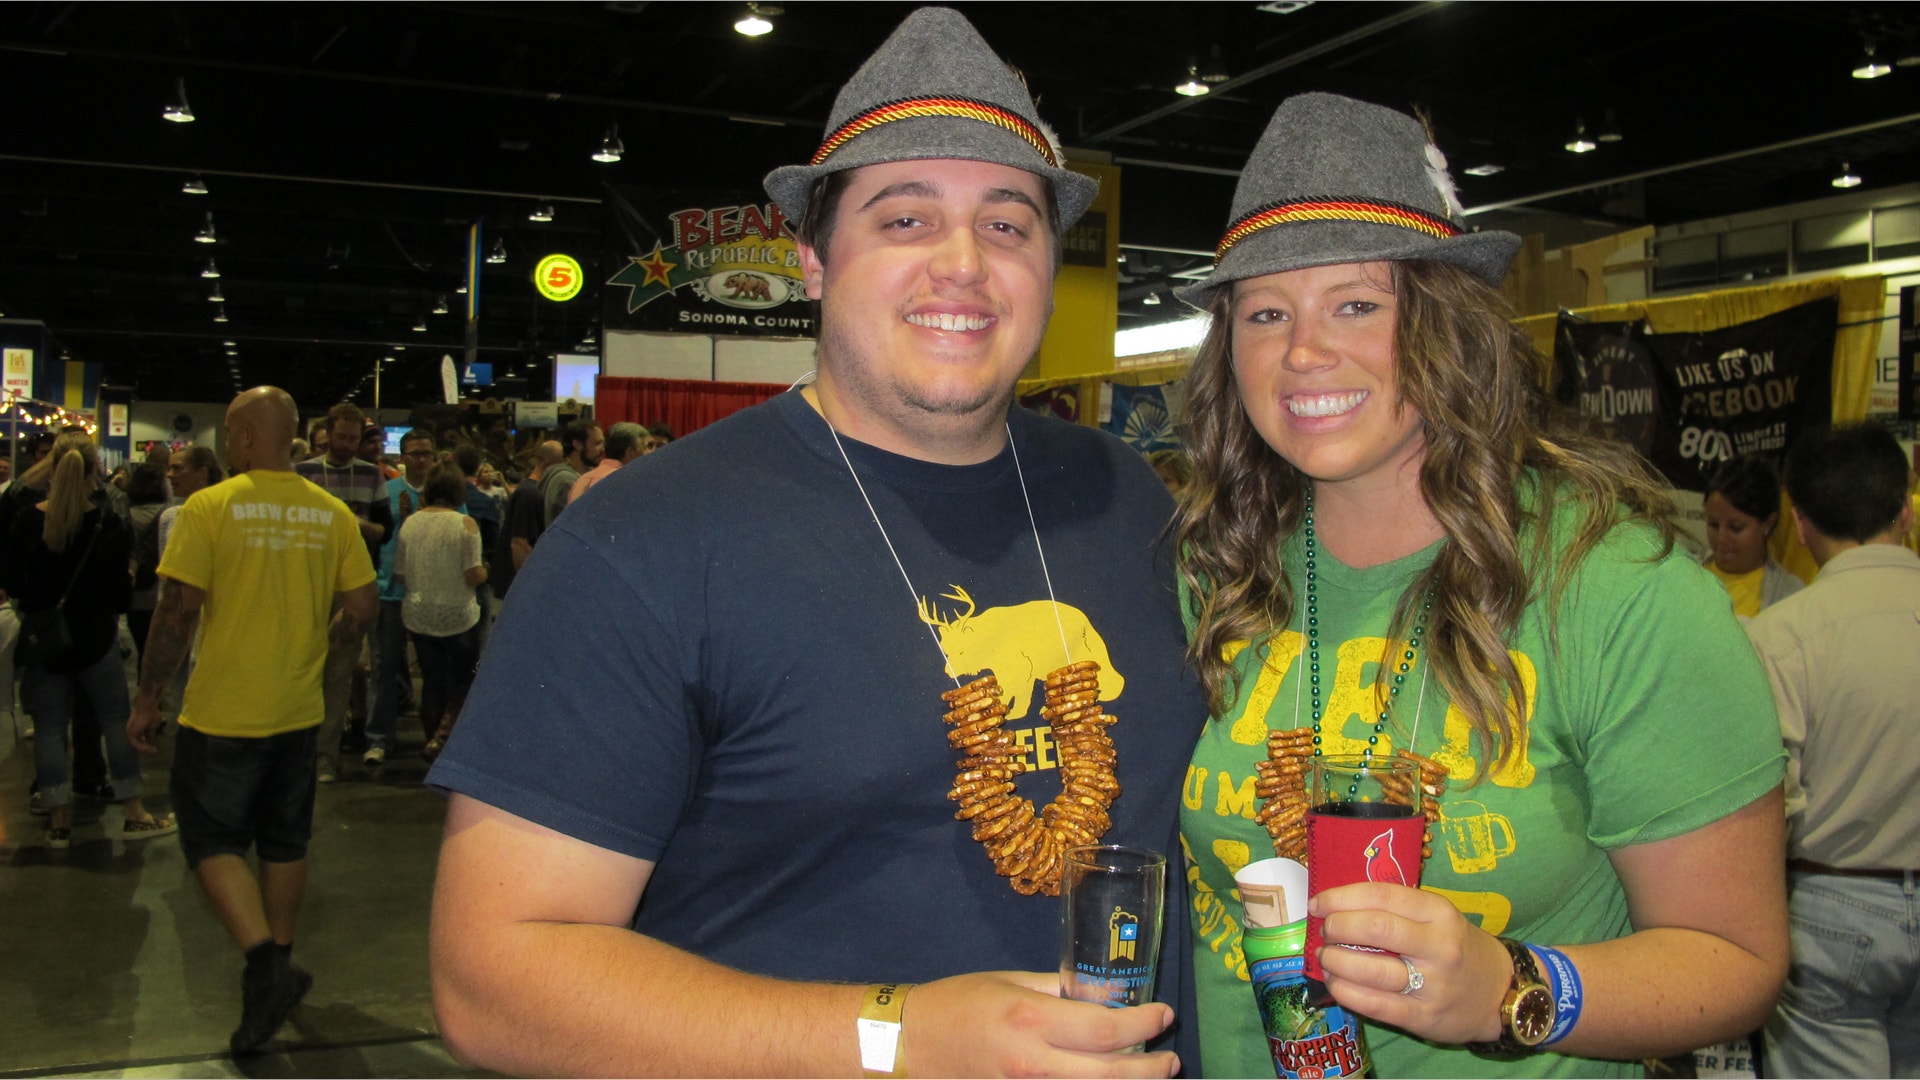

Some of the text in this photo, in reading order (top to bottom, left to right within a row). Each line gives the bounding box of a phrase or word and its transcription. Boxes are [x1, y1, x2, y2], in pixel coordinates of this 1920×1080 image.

[686, 247, 778, 271] REPUBLIC
[547, 266, 572, 287] 5
[754, 316, 815, 329] COUNT
[1676, 350, 1774, 387] LIKE US ON
[232, 503, 333, 526] BREW CREW
[1077, 963, 1107, 974] GREAT
[1077, 972, 1107, 988] BEER
[1109, 990, 1129, 999] 2014
[1301, 1069, 1319, 1079] ale
